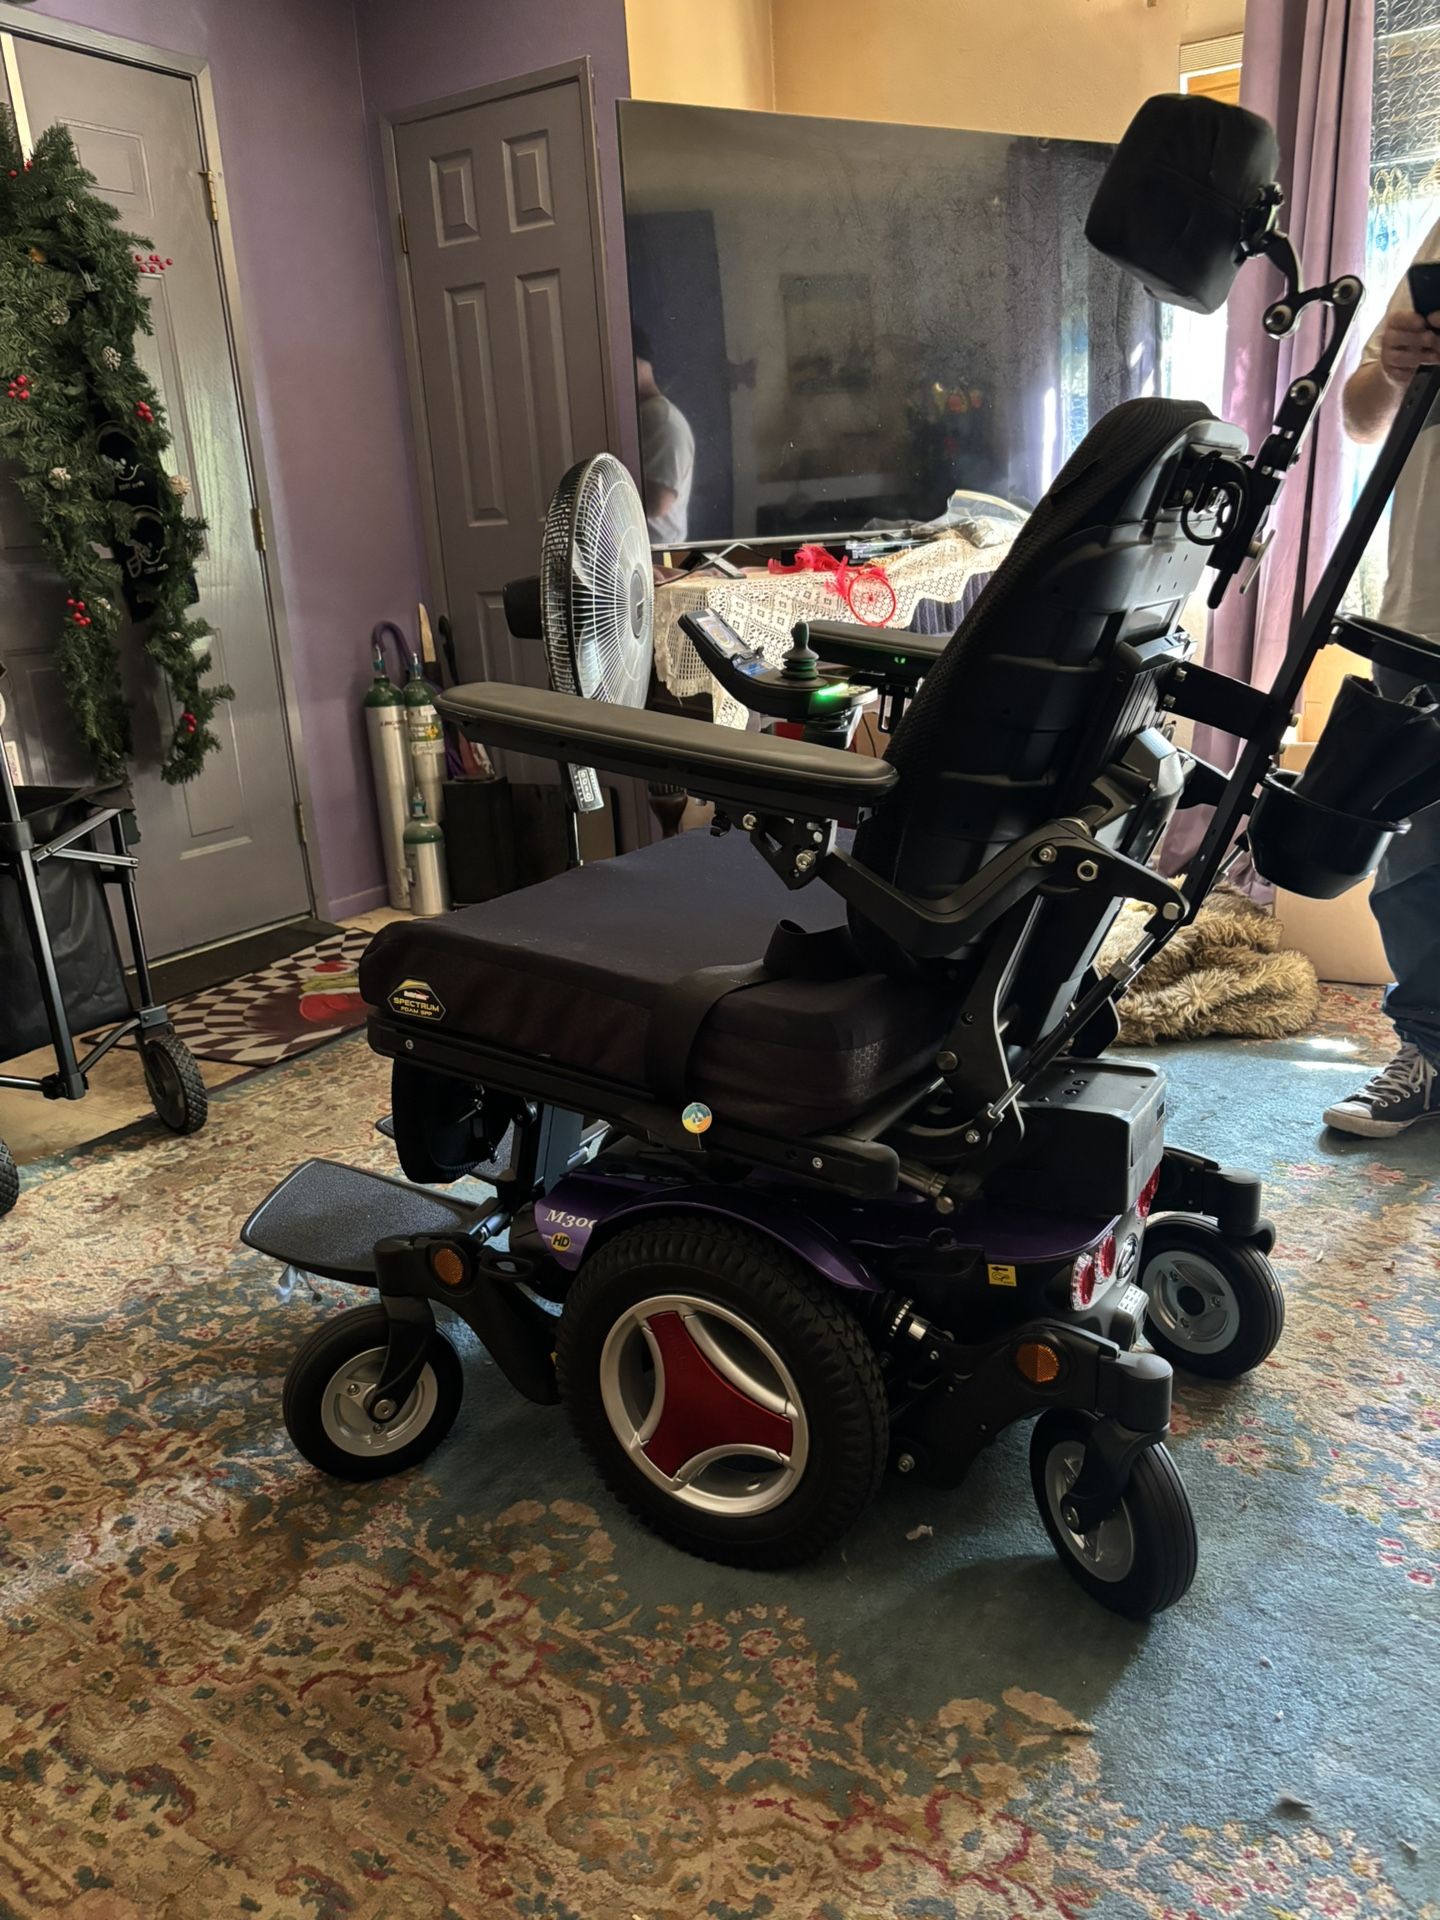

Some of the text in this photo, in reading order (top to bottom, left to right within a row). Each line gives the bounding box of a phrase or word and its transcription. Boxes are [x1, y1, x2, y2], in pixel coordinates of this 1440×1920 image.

[393, 997, 440, 1012] SPECTRUM
[400, 1006, 419, 1014] FOAM
[552, 1234, 570, 1248] HD
